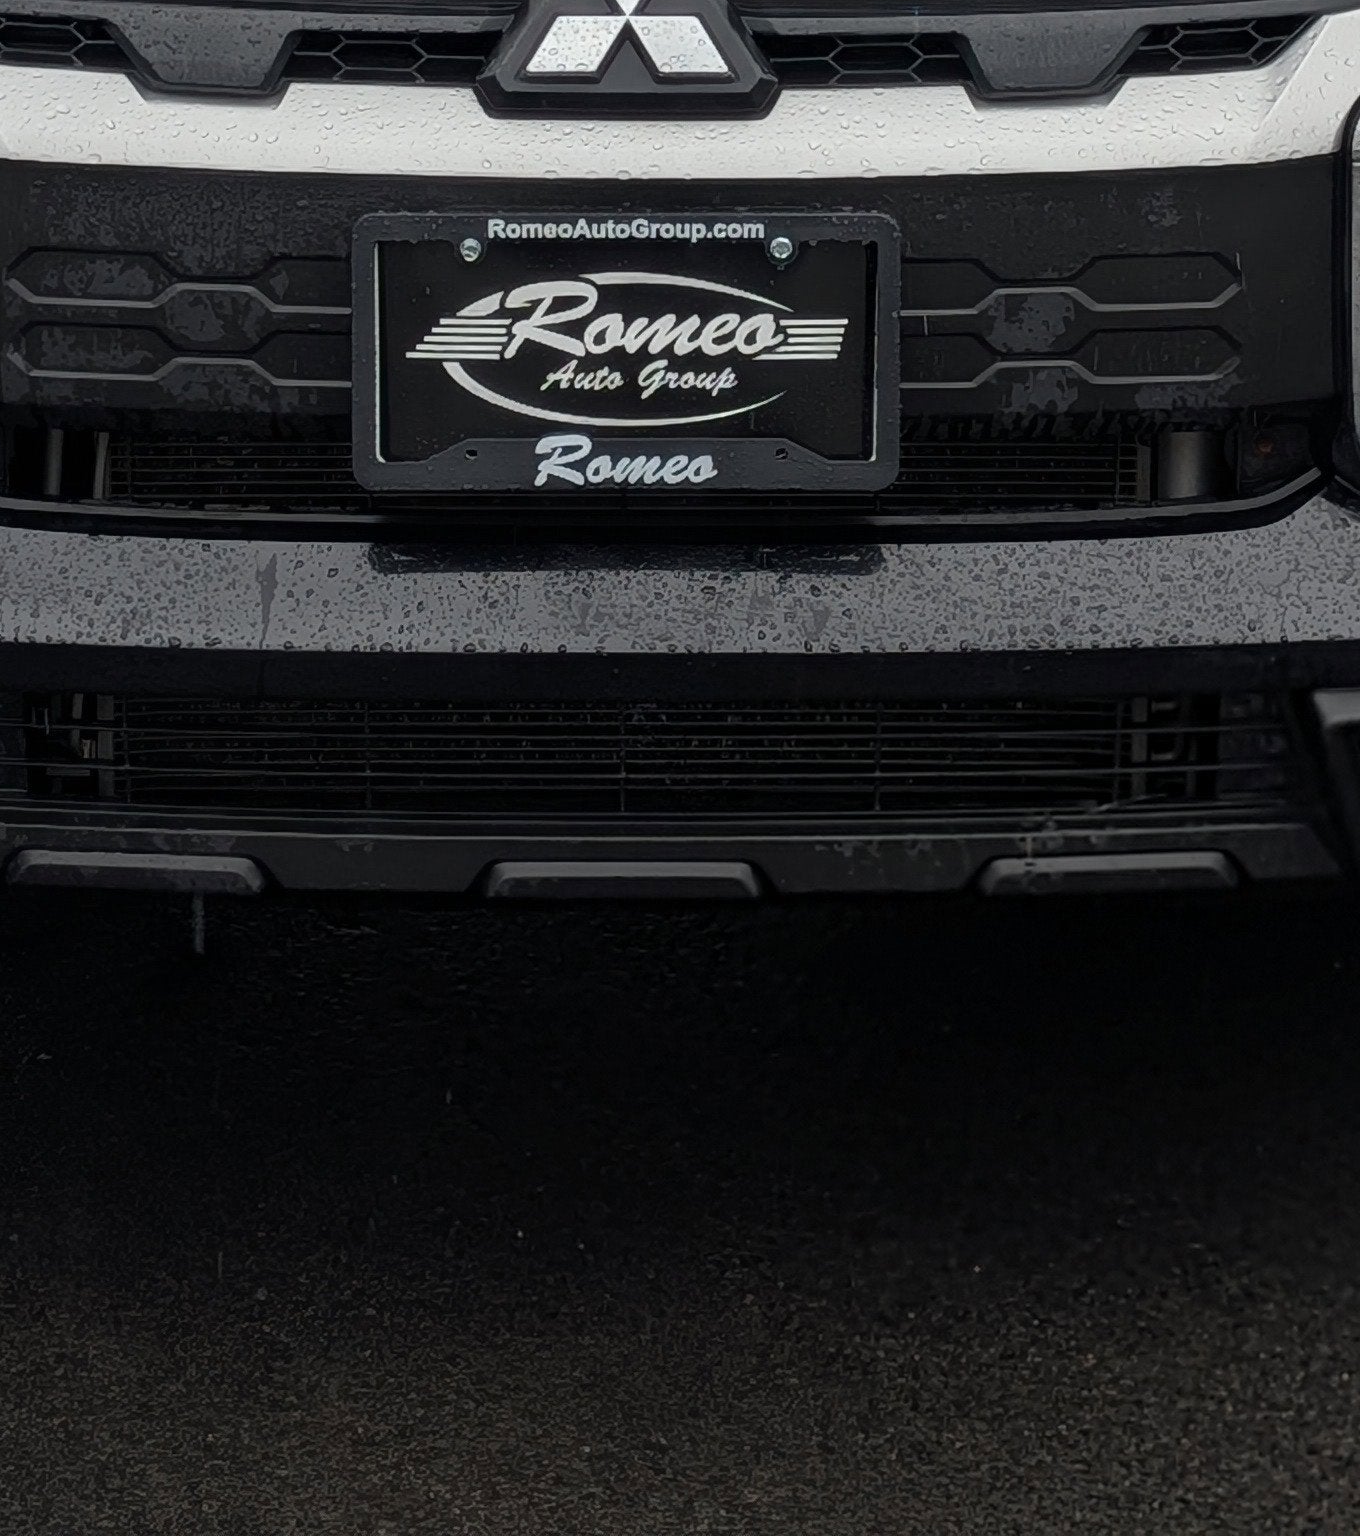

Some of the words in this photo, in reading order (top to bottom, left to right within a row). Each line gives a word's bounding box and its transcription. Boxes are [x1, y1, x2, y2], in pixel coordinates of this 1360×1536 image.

[487, 219, 765, 242] RomeoAutoGroup.com
[505, 281, 785, 358] Romeo
[540, 360, 625, 391] Auto
[637, 361, 738, 398] Group
[535, 435, 718, 486] Romeo
